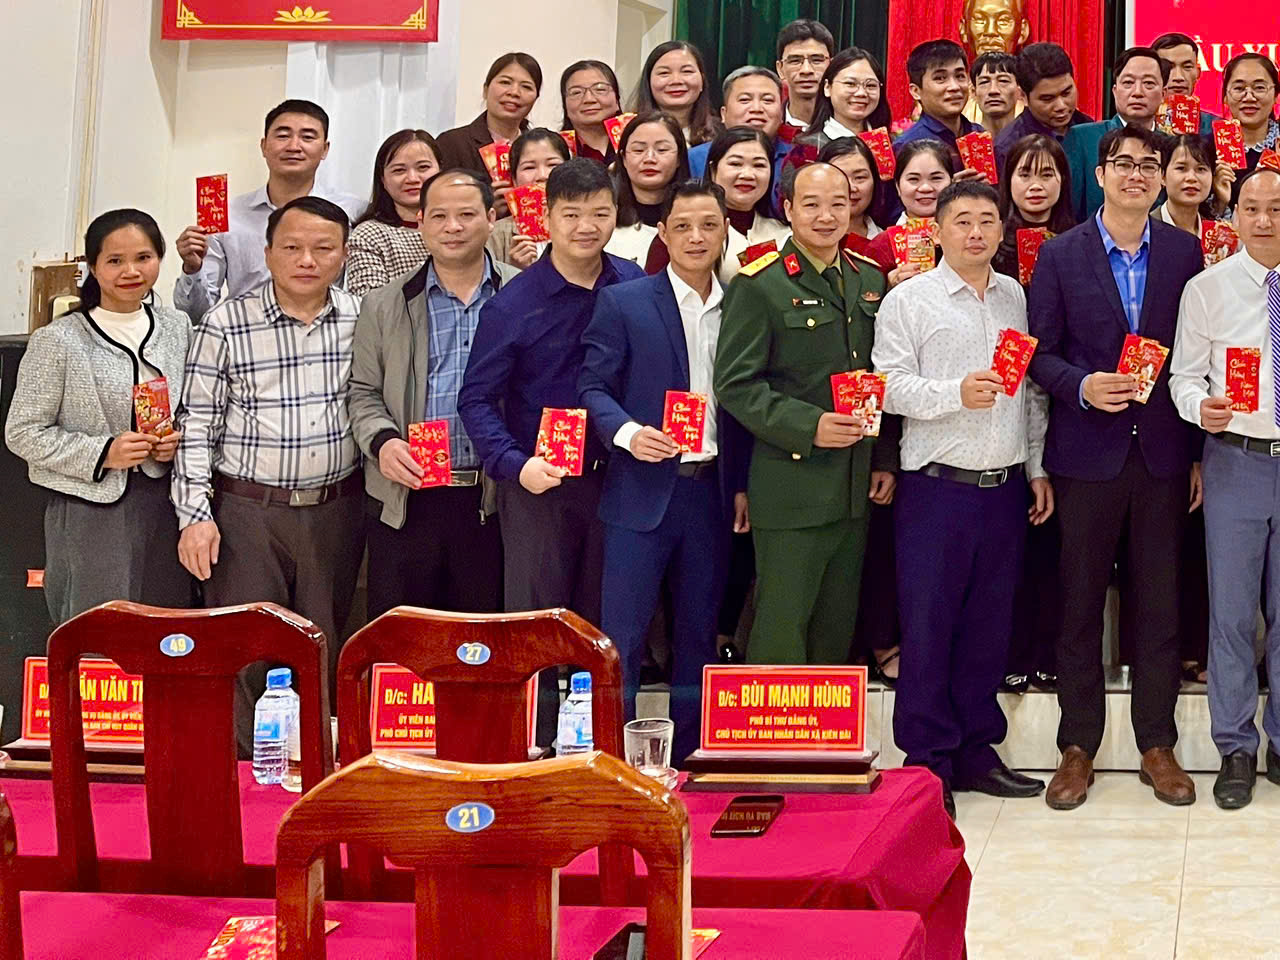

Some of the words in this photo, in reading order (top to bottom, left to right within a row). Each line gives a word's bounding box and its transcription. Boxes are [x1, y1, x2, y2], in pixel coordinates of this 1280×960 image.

[170, 638, 187, 653] 49
[465, 644, 482, 661] 27
[100, 675, 128, 702] VĂN
[741, 680, 765, 708] BÙI
[768, 684, 810, 713] MẠNH
[813, 680, 852, 708] HÙNG
[458, 806, 481, 828] 21
